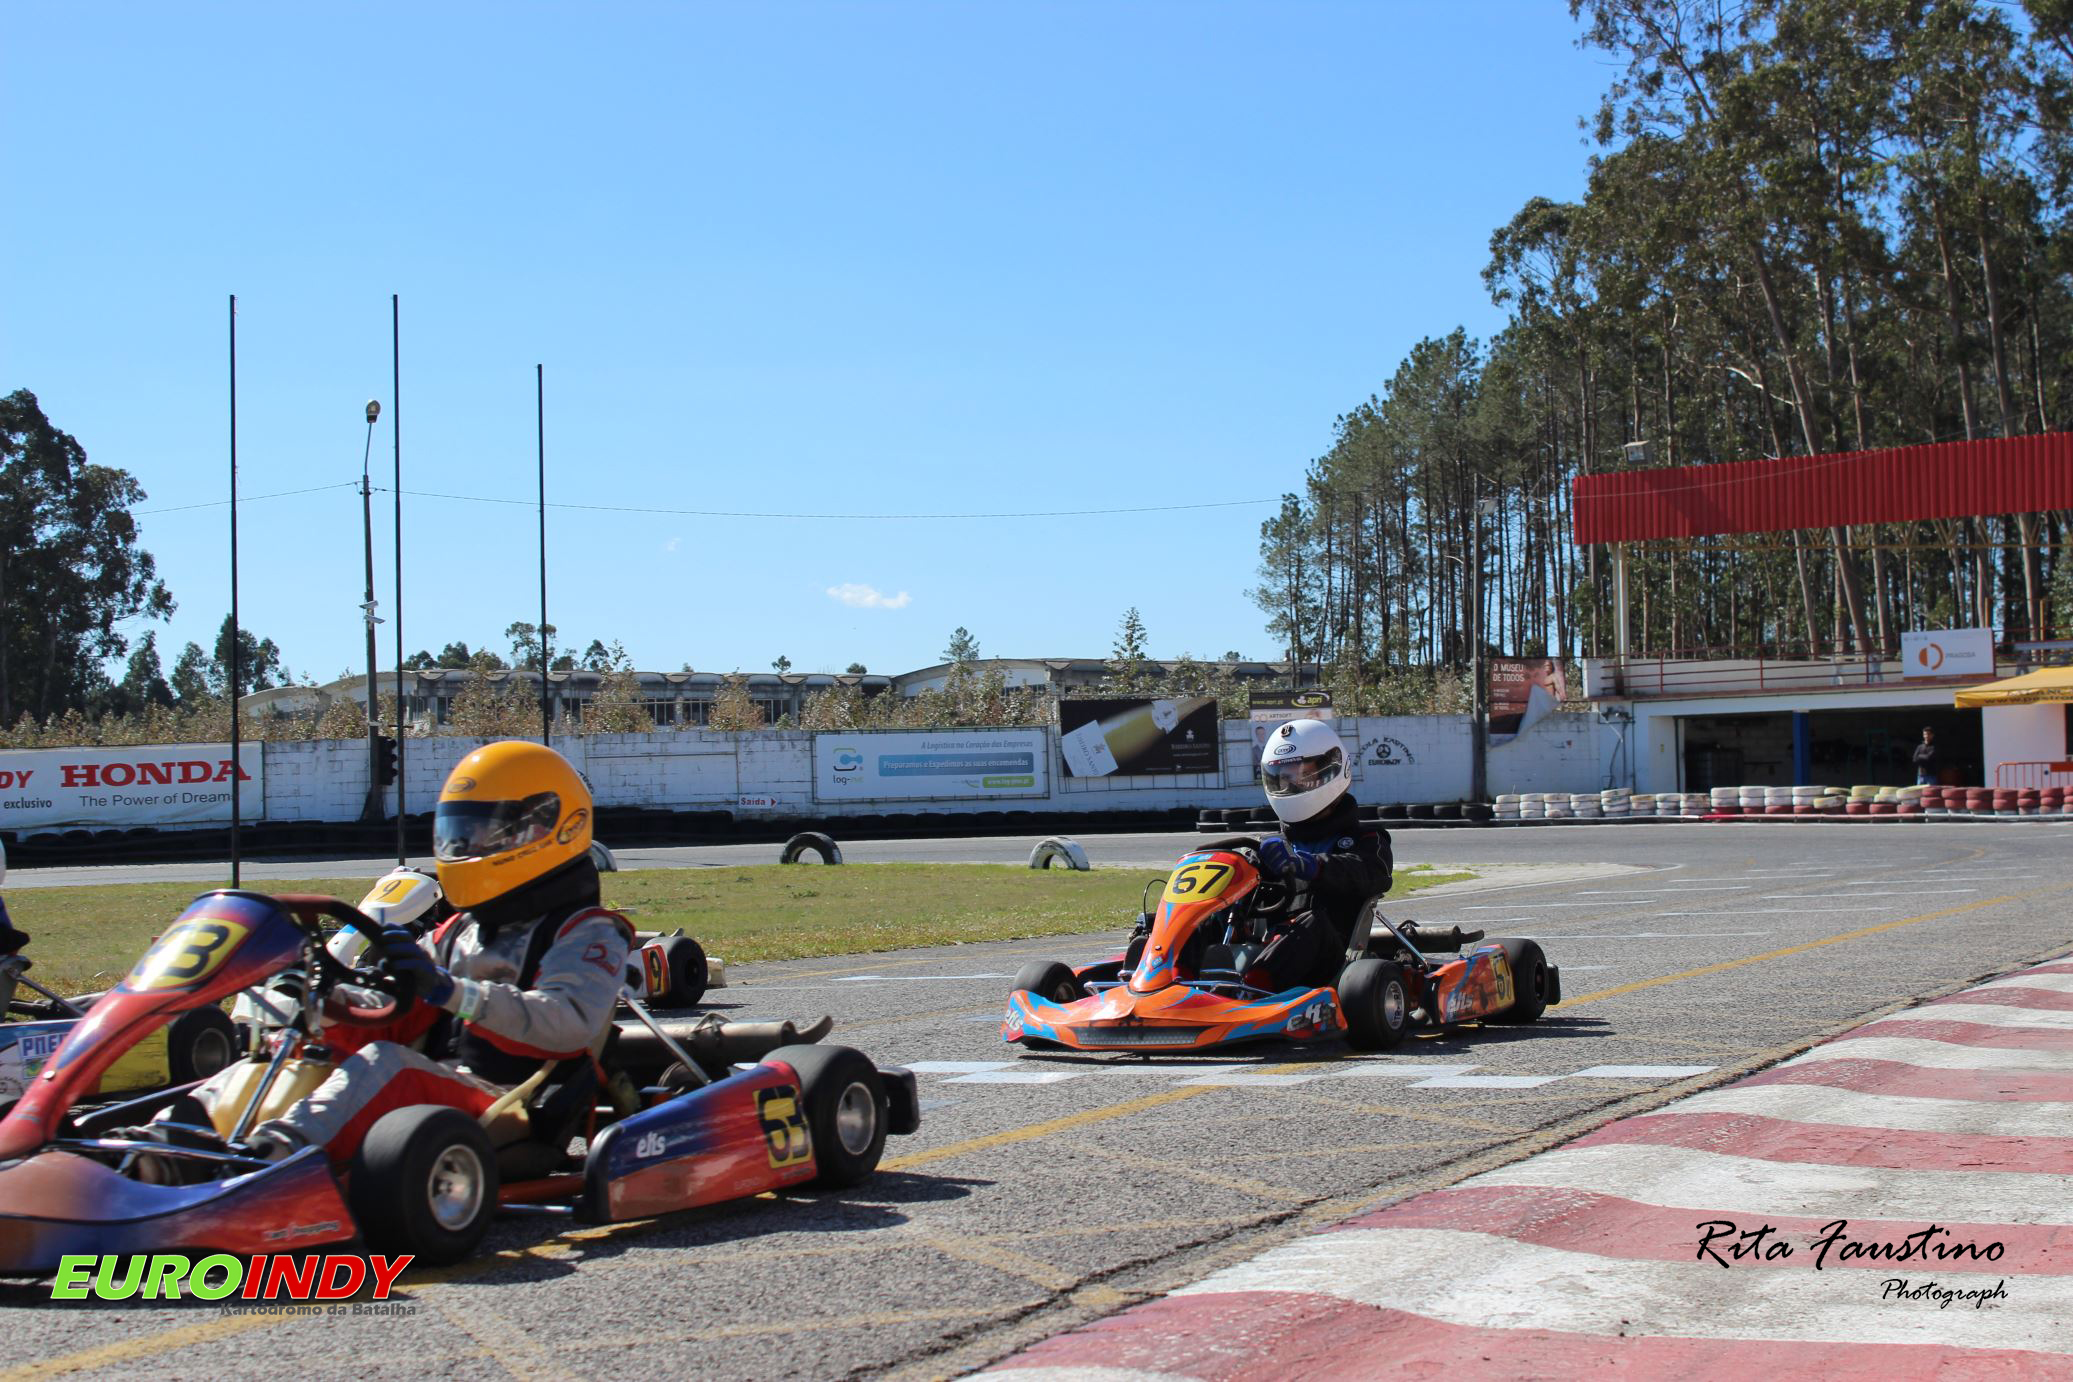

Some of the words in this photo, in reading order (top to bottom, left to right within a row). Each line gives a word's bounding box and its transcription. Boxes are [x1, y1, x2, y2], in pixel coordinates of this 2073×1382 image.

[1493, 664, 1499, 672] O
[60, 760, 252, 788] HONDA
[3, 797, 53, 809] exclusivo
[79, 795, 107, 807] The
[112, 792, 159, 806] Power
[163, 792, 178, 804] of
[182, 792, 235, 804] Dream
[1172, 864, 1230, 895] 67
[649, 950, 663, 992] 9
